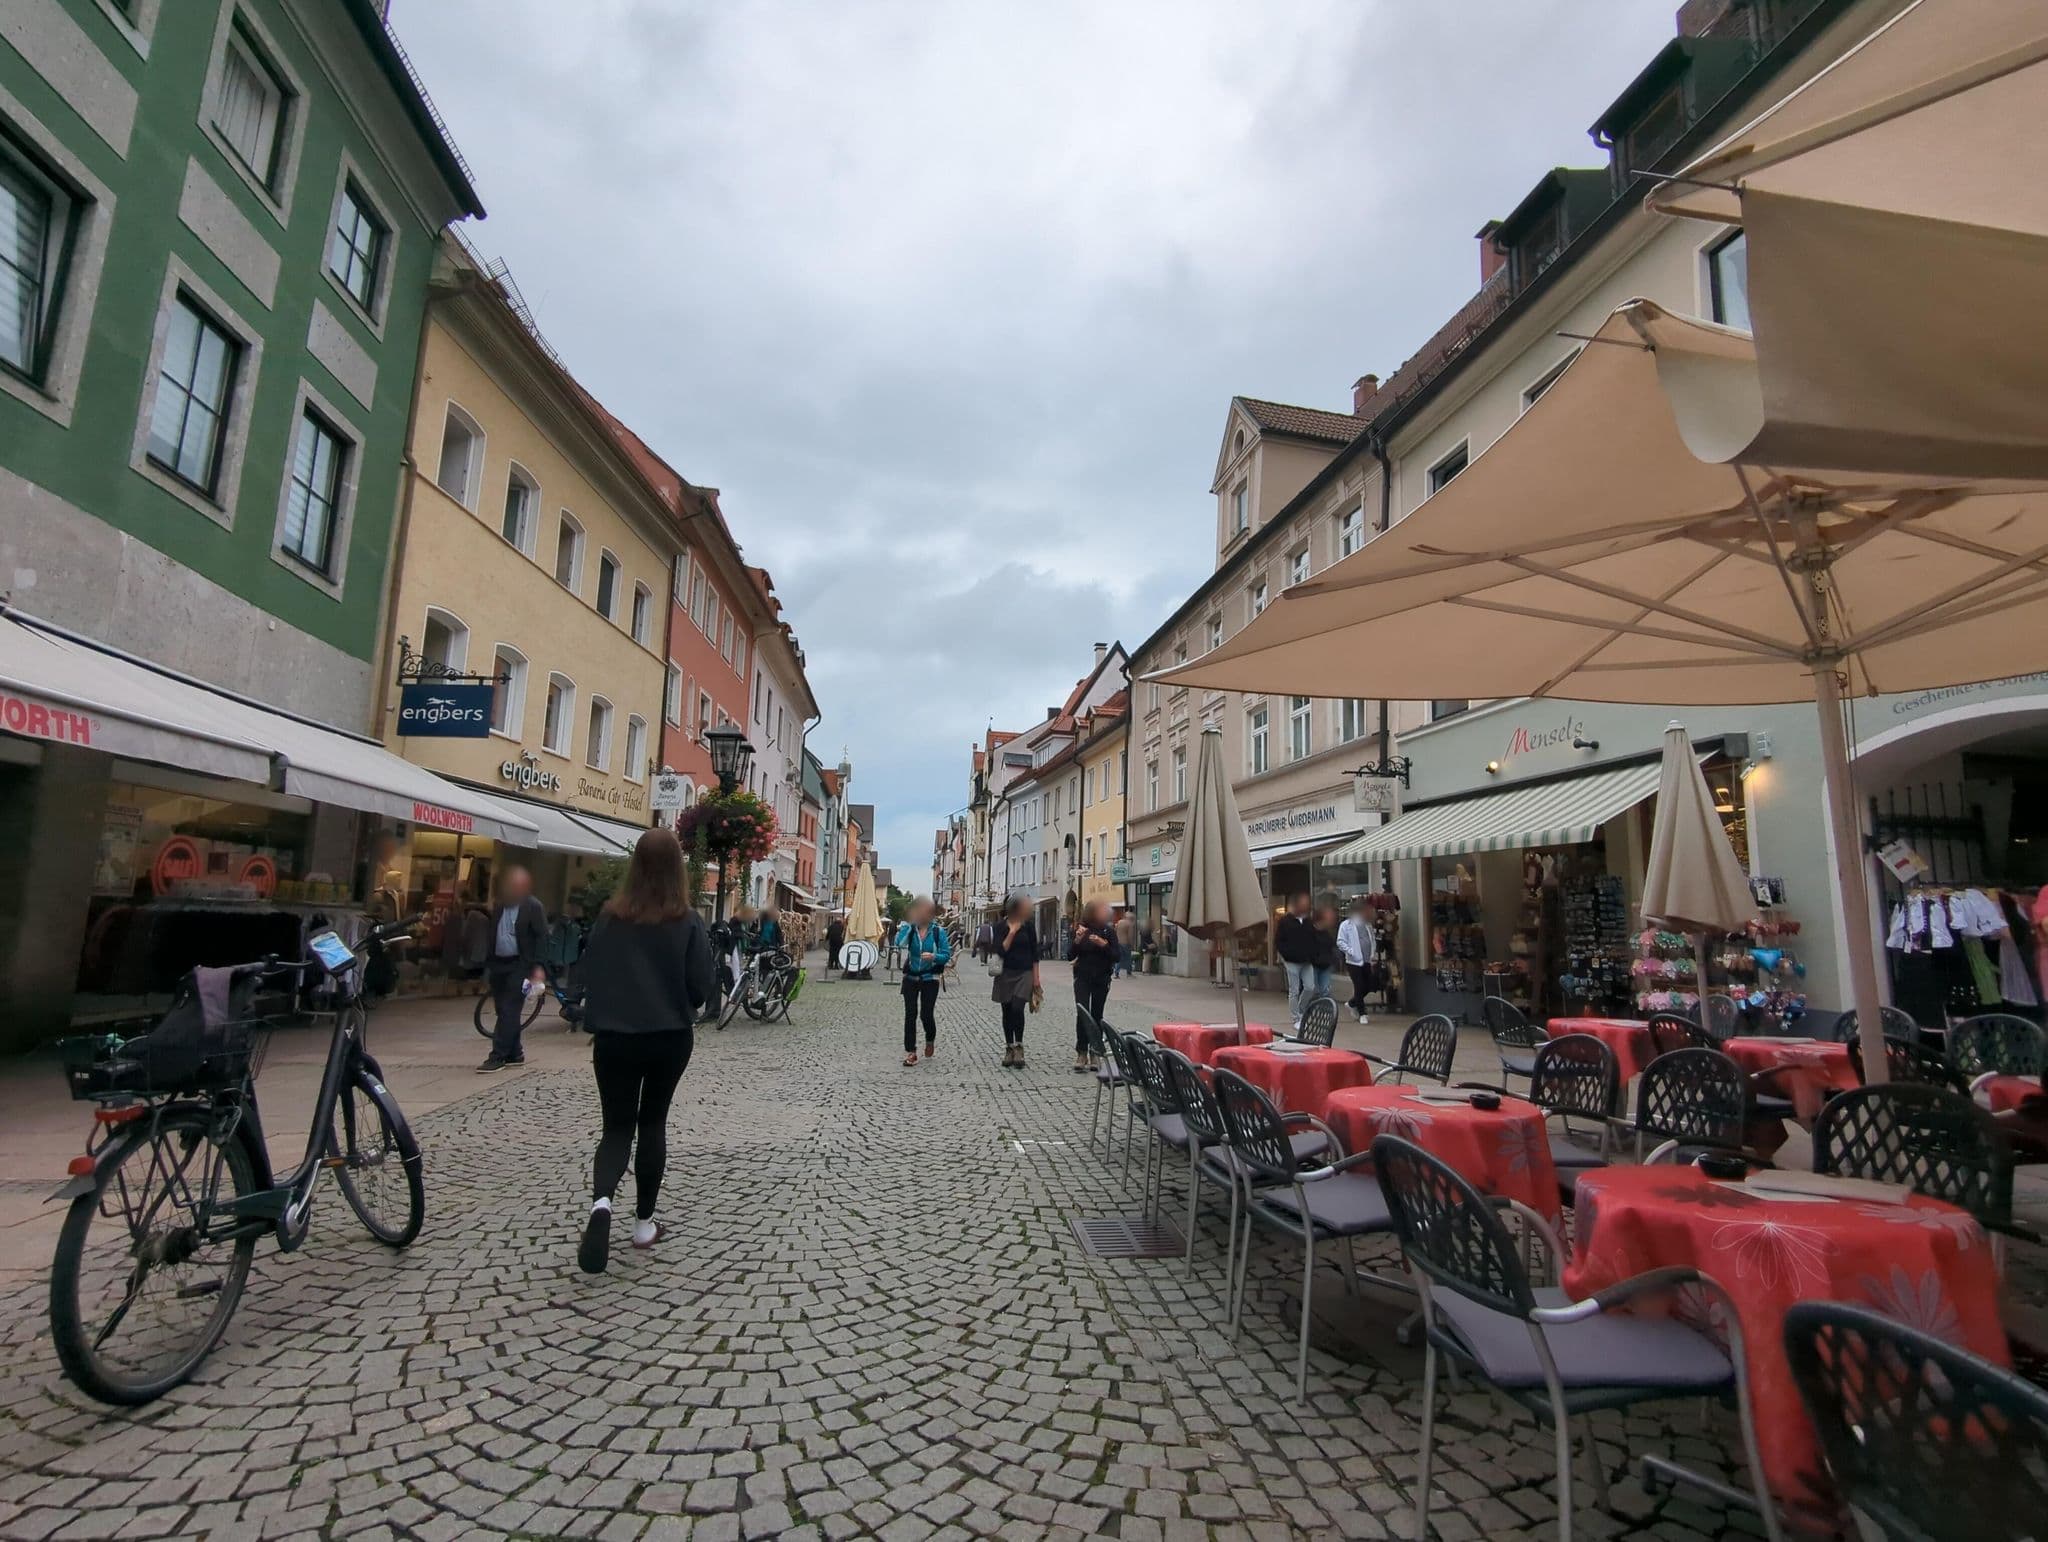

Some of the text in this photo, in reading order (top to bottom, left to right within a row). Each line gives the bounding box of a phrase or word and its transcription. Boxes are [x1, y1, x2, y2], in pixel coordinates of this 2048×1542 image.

[0, 696, 90, 745] ORTH
[402, 704, 484, 724] engbers
[1504, 716, 1583, 762] Mensels
[501, 760, 561, 792] engbers
[577, 777, 607, 801] Bavaria
[607, 787, 621, 815] City
[413, 801, 473, 833] WOOLWORTH
[1287, 806, 1335, 827] WIEDEMANN
